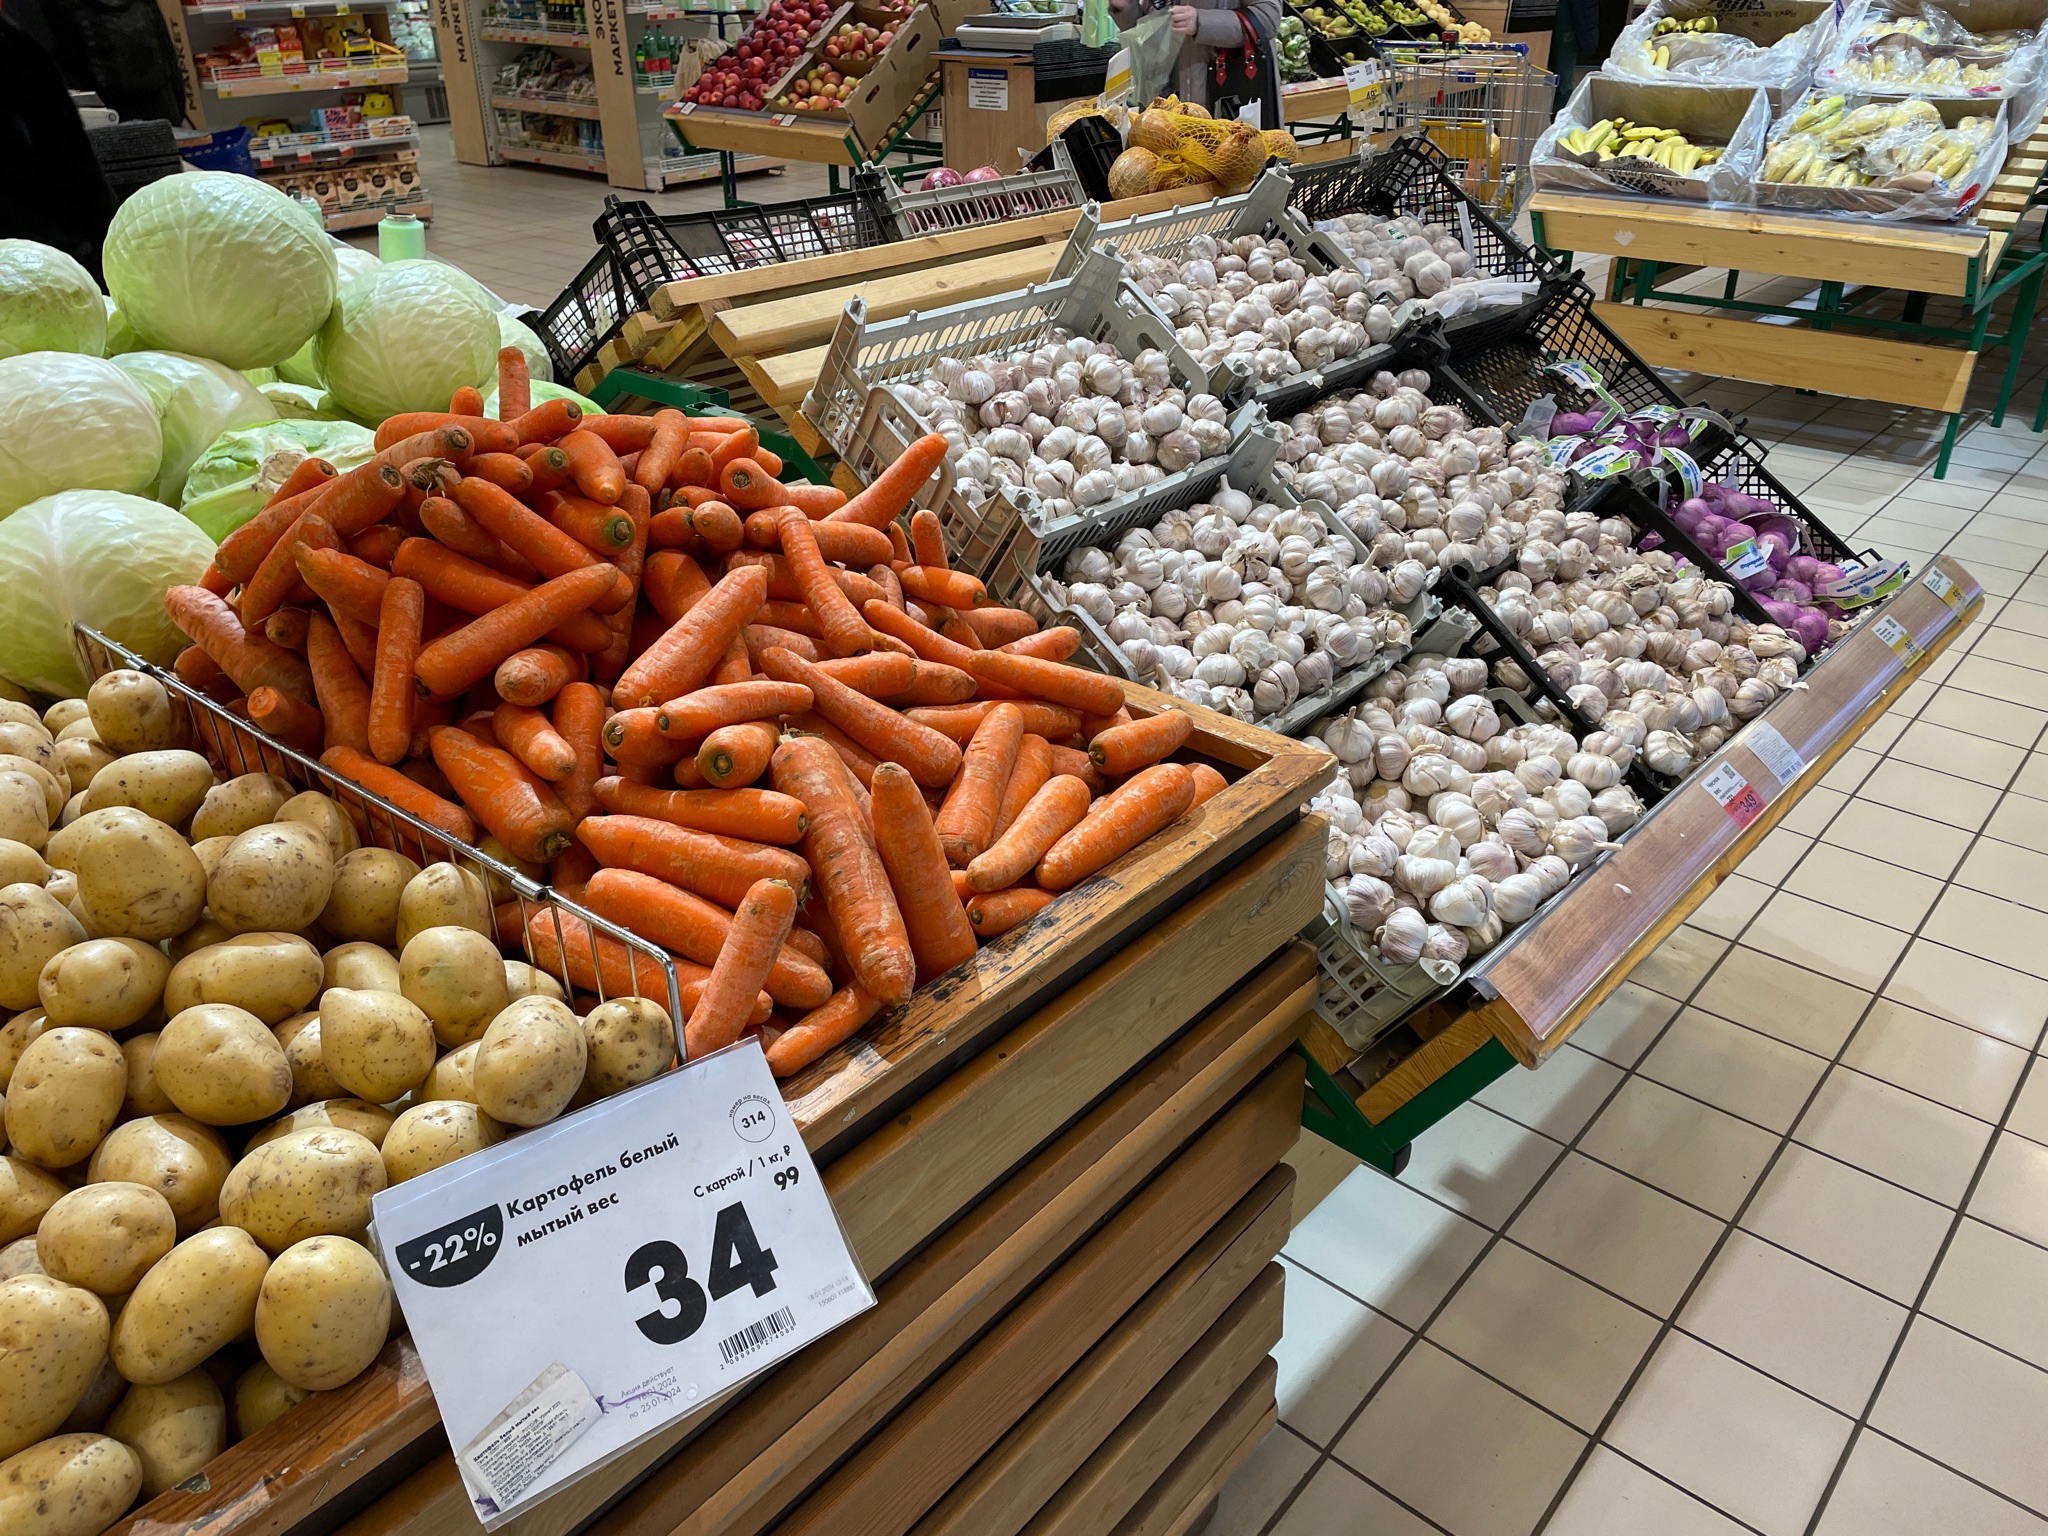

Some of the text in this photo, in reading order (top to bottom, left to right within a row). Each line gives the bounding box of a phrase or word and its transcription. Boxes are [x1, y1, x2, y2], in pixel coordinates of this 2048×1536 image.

[439, 0, 450, 28] ЭК
[450, 0, 467, 62] МАРКЕ
[1740, 793, 1757, 813] 349
[741, 1110, 766, 1129] 314
[506, 1133, 680, 1219] Картофель белый
[693, 1185, 705, 1198] С
[706, 1166, 746, 1193] картой
[758, 1156, 766, 1168] 1
[773, 1166, 800, 1191] 99
[517, 1190, 620, 1248] мытый вес
[409, 1221, 497, 1273] -22%
[624, 1200, 779, 1346] 34
[621, 1366, 674, 1399] Акция действует
[629, 1411, 639, 1420] по
